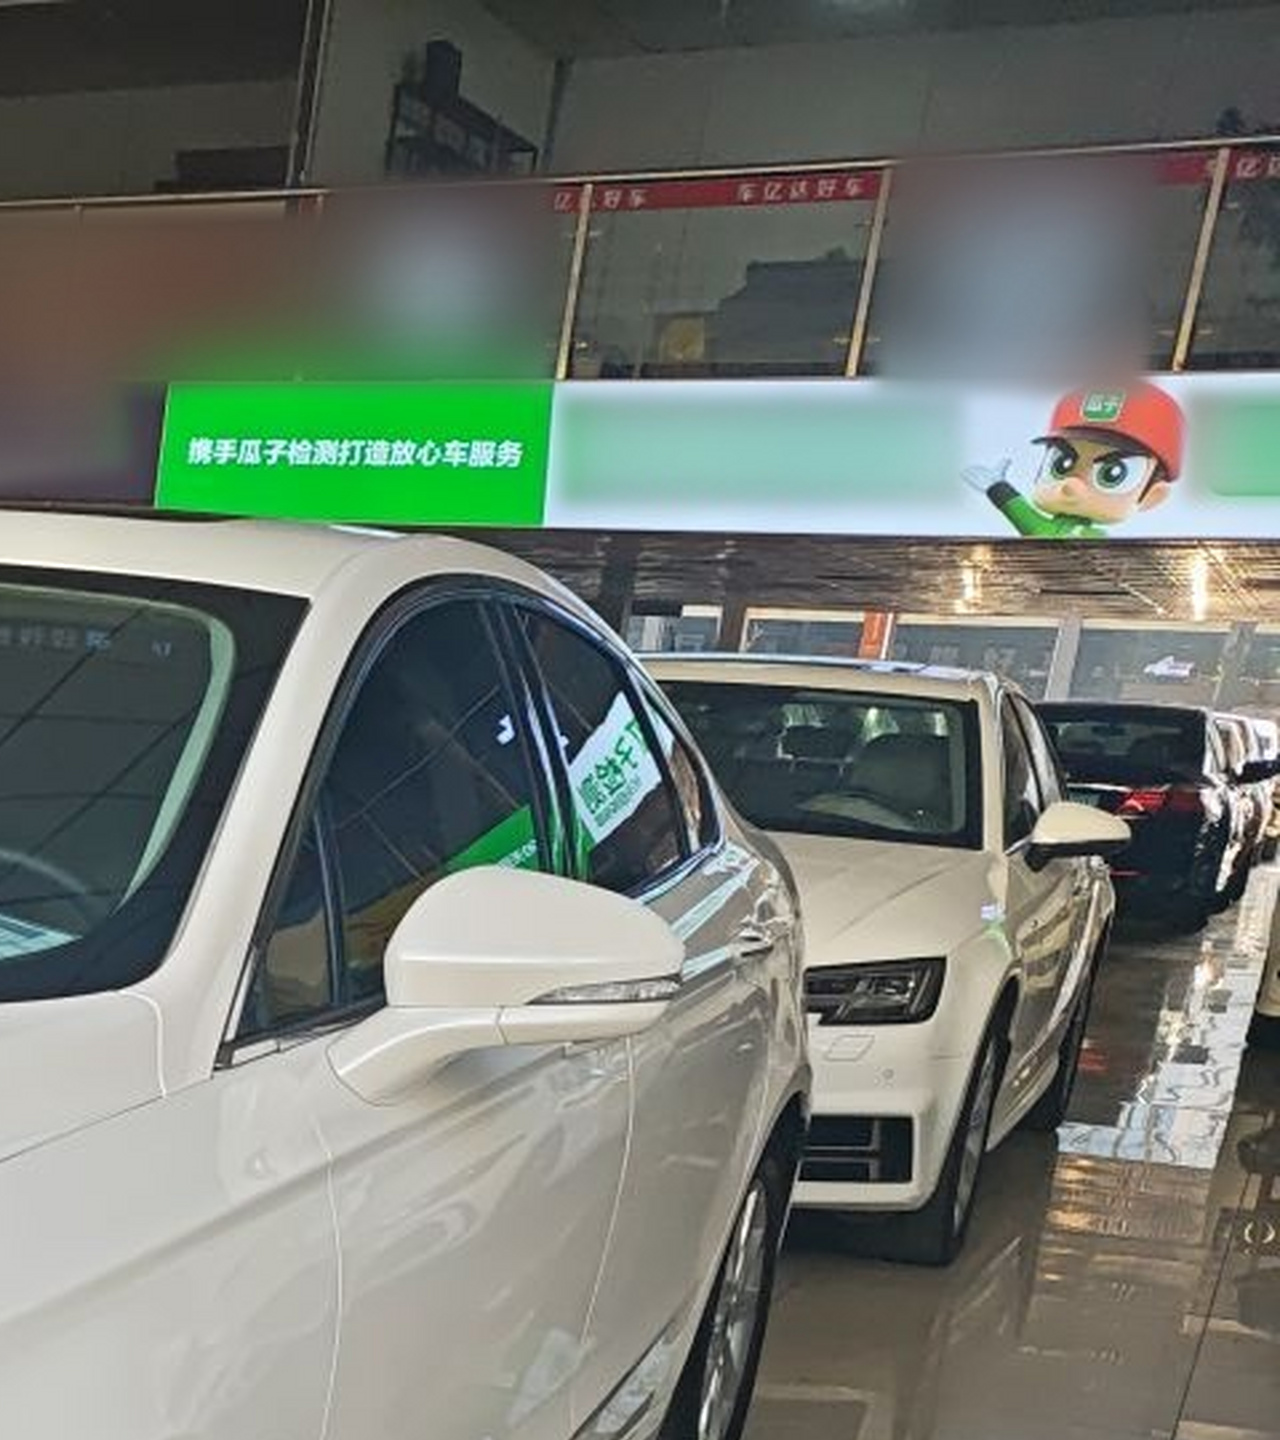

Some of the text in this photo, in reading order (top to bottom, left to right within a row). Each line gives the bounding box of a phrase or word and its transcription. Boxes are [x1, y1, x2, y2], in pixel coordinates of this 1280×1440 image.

[187, 437, 524, 468] 携手瓜子检测打造放心车服务
